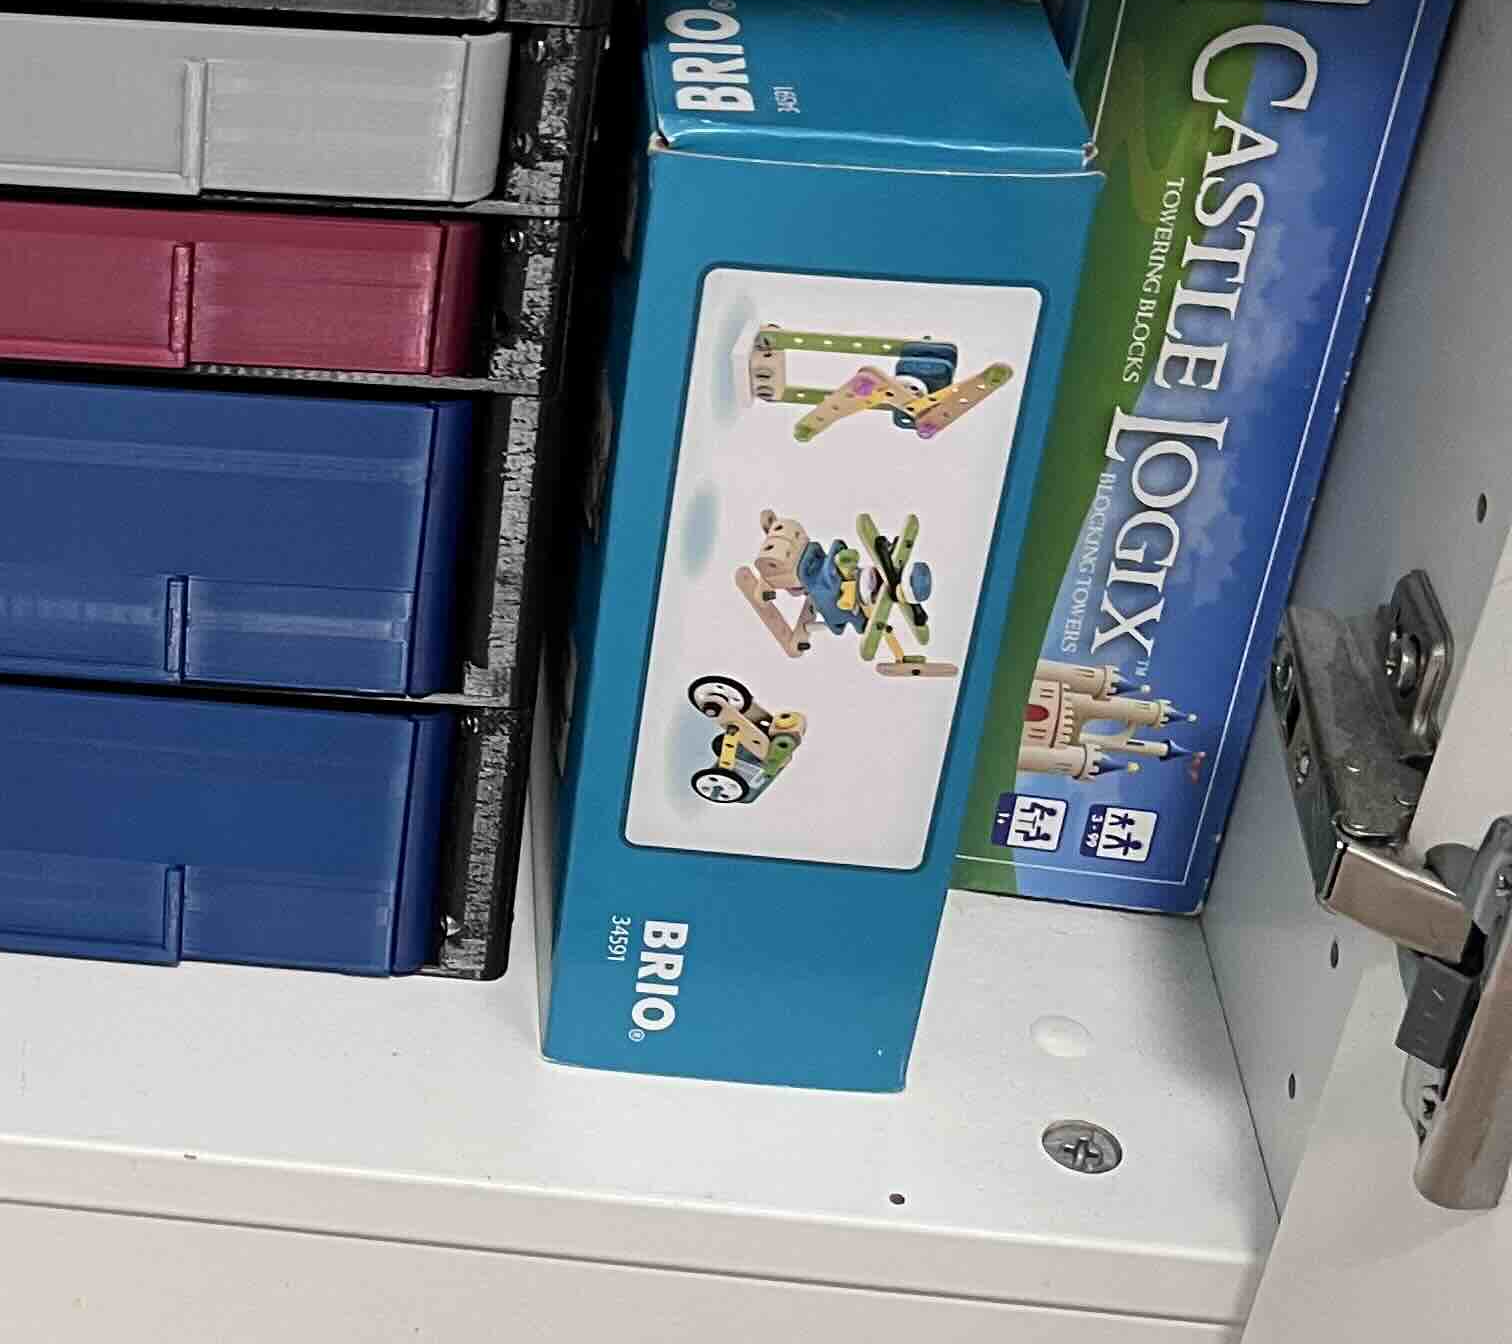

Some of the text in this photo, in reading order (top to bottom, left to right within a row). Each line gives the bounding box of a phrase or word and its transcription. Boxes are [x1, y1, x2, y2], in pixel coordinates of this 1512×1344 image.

[1090, 23, 1319, 657] CASTLE LOGIX
[1122, 176, 1186, 384] TOWERING BLOCKS
[1060, 471, 1117, 655] BLOCKING TOWERS
[607, 914, 632, 962] 34591
